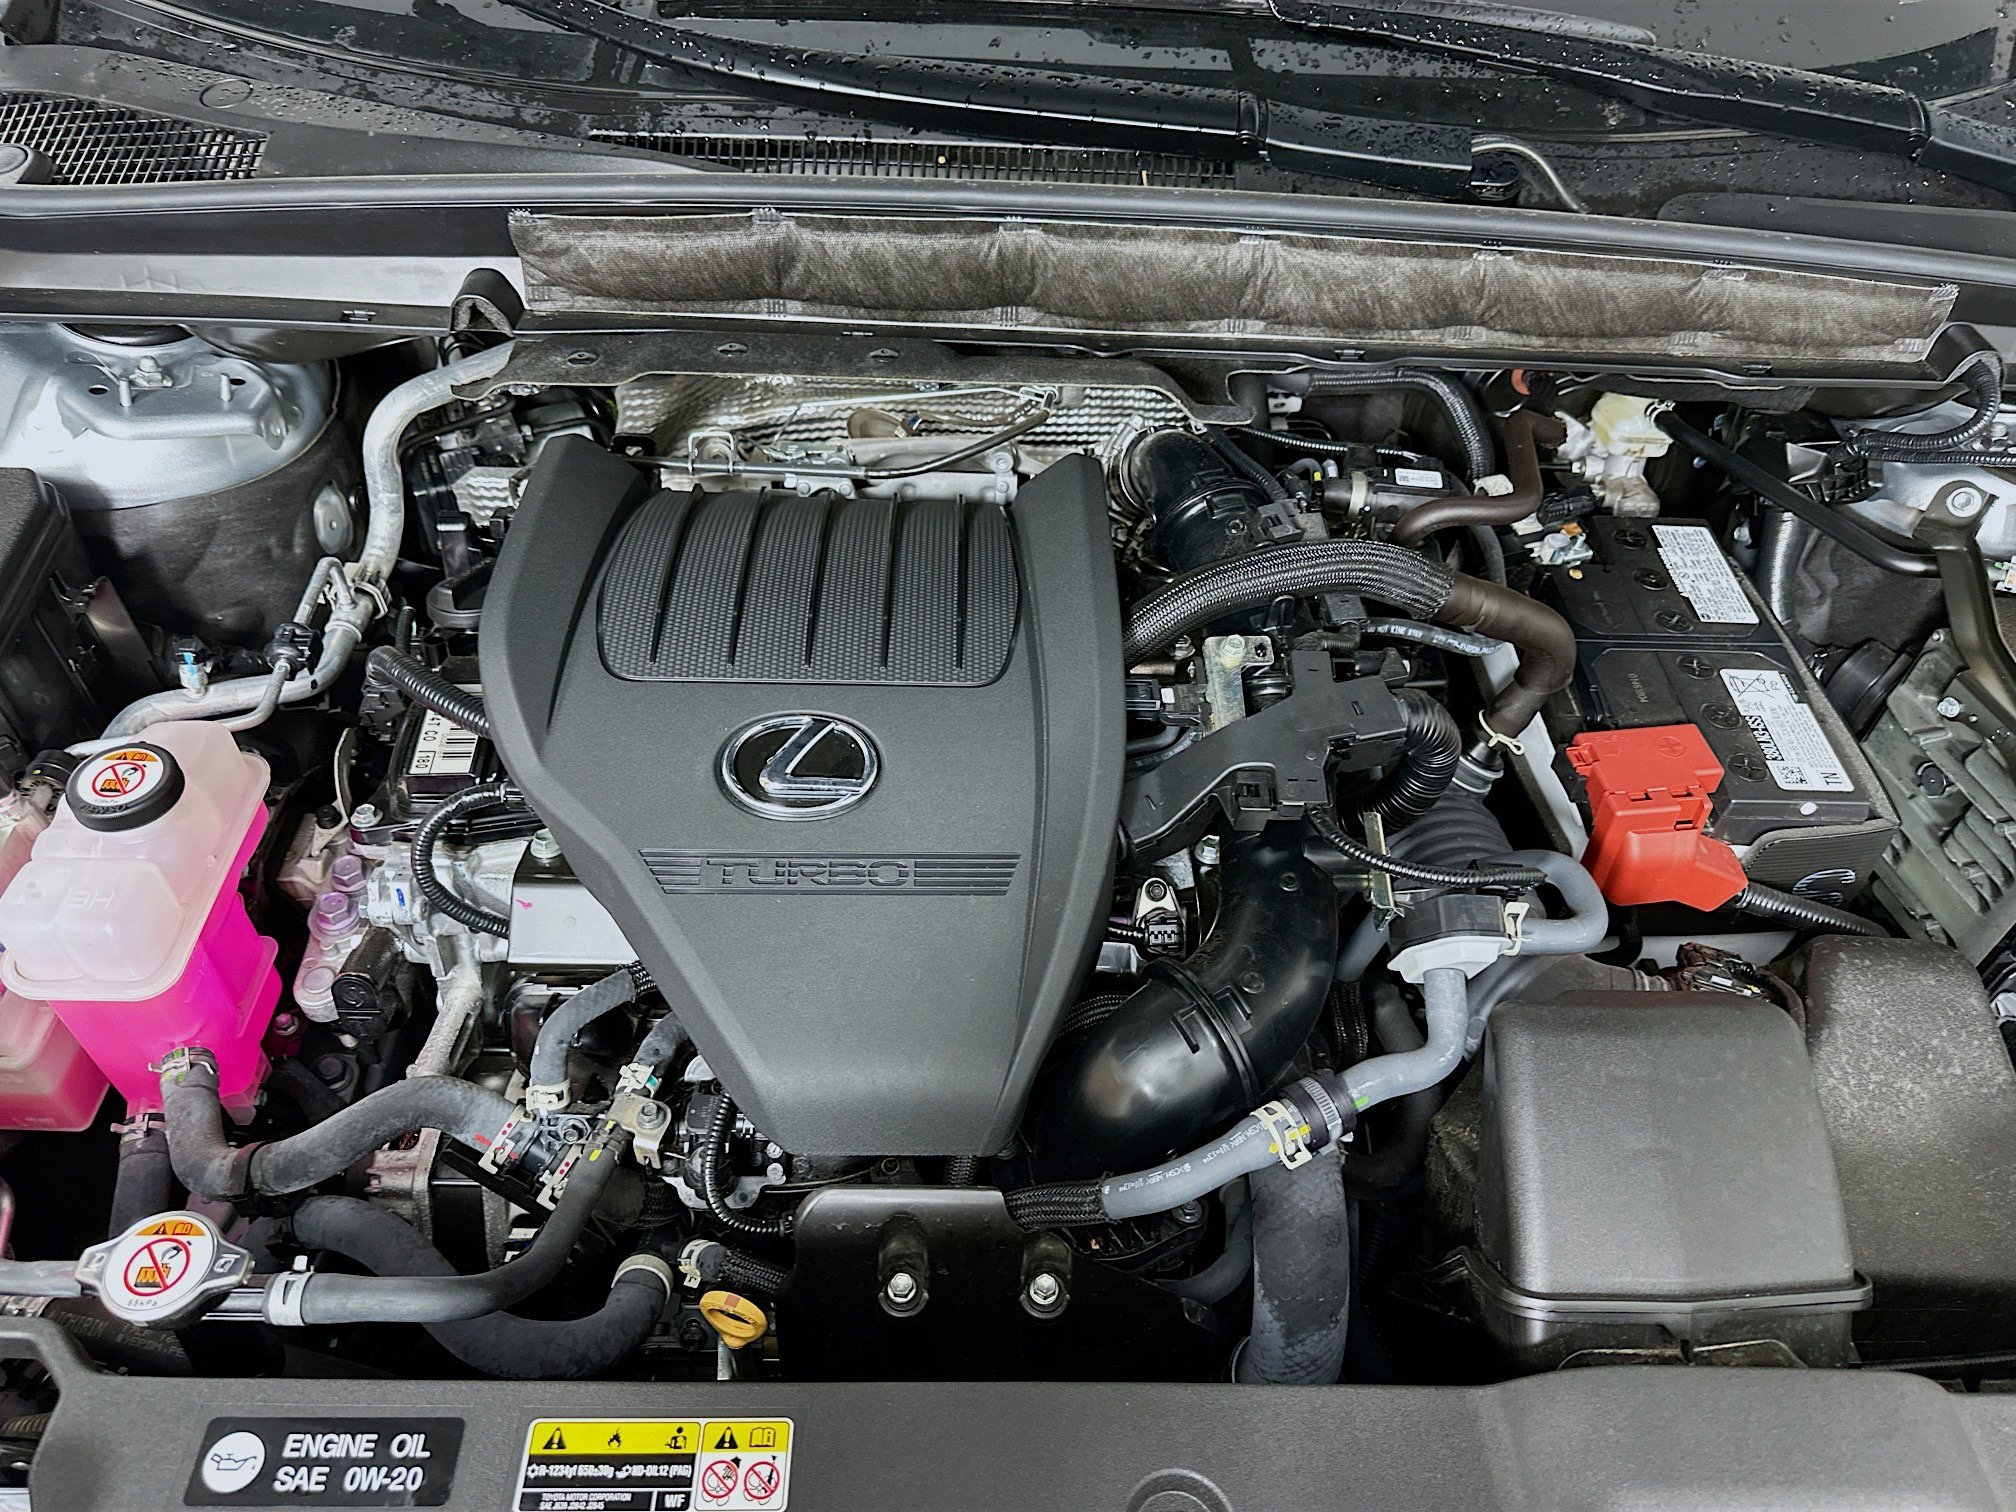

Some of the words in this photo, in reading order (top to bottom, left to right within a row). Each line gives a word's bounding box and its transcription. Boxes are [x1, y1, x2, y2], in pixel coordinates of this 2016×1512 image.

[1745, 715, 1783, 761] 380LN3-ISS
[415, 755, 430, 769] 180
[1820, 771, 1843, 786] TN
[706, 858, 910, 886] TURBO
[126, 1299, 159, 1307] 88kPa
[281, 1433, 379, 1459] ENGINE
[389, 1433, 431, 1459] OIL
[272, 1465, 330, 1493] SAE
[343, 1466, 424, 1492] 0W-20
[538, 1464, 577, 1479] R-1234yf
[669, 1464, 692, 1478] (PAG)
[541, 1493, 566, 1501] TOYOTA
[566, 1493, 589, 1501] MOTOR
[589, 1493, 632, 1502] CORPORATION
[663, 1493, 686, 1509] WF
